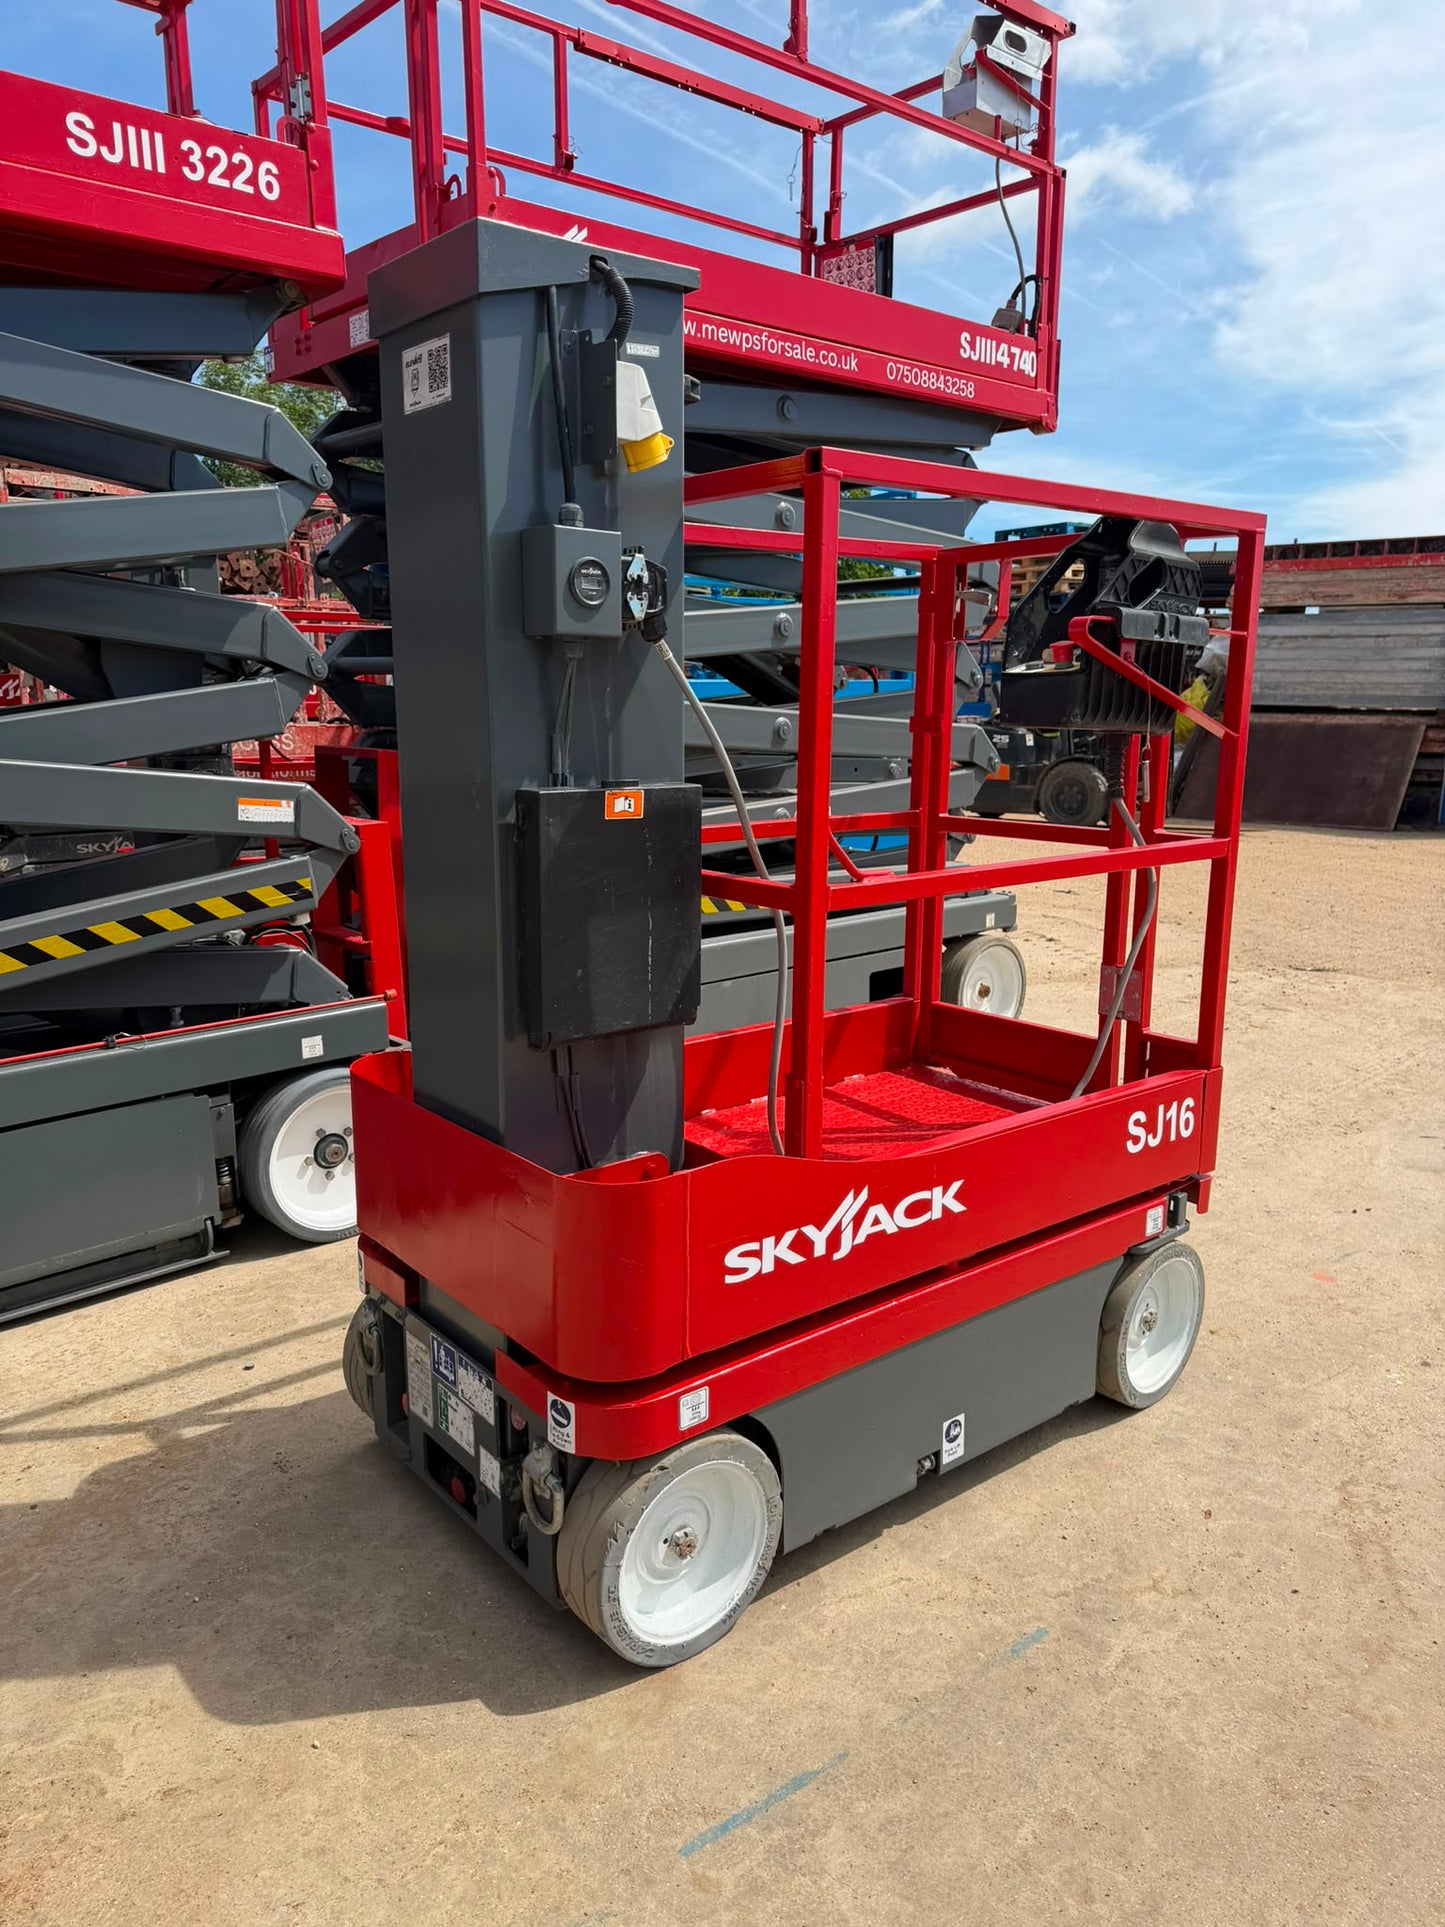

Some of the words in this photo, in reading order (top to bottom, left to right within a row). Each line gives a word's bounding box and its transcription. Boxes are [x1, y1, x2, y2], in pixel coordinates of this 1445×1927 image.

[65, 111, 166, 174] SJIII
[180, 139, 281, 201] 3226
[886, 362, 975, 399] 07508843258
[76, 836, 135, 854] SKYJA
[1126, 1096, 1195, 1154] SJ16
[724, 1179, 968, 1284] SKYJACK
